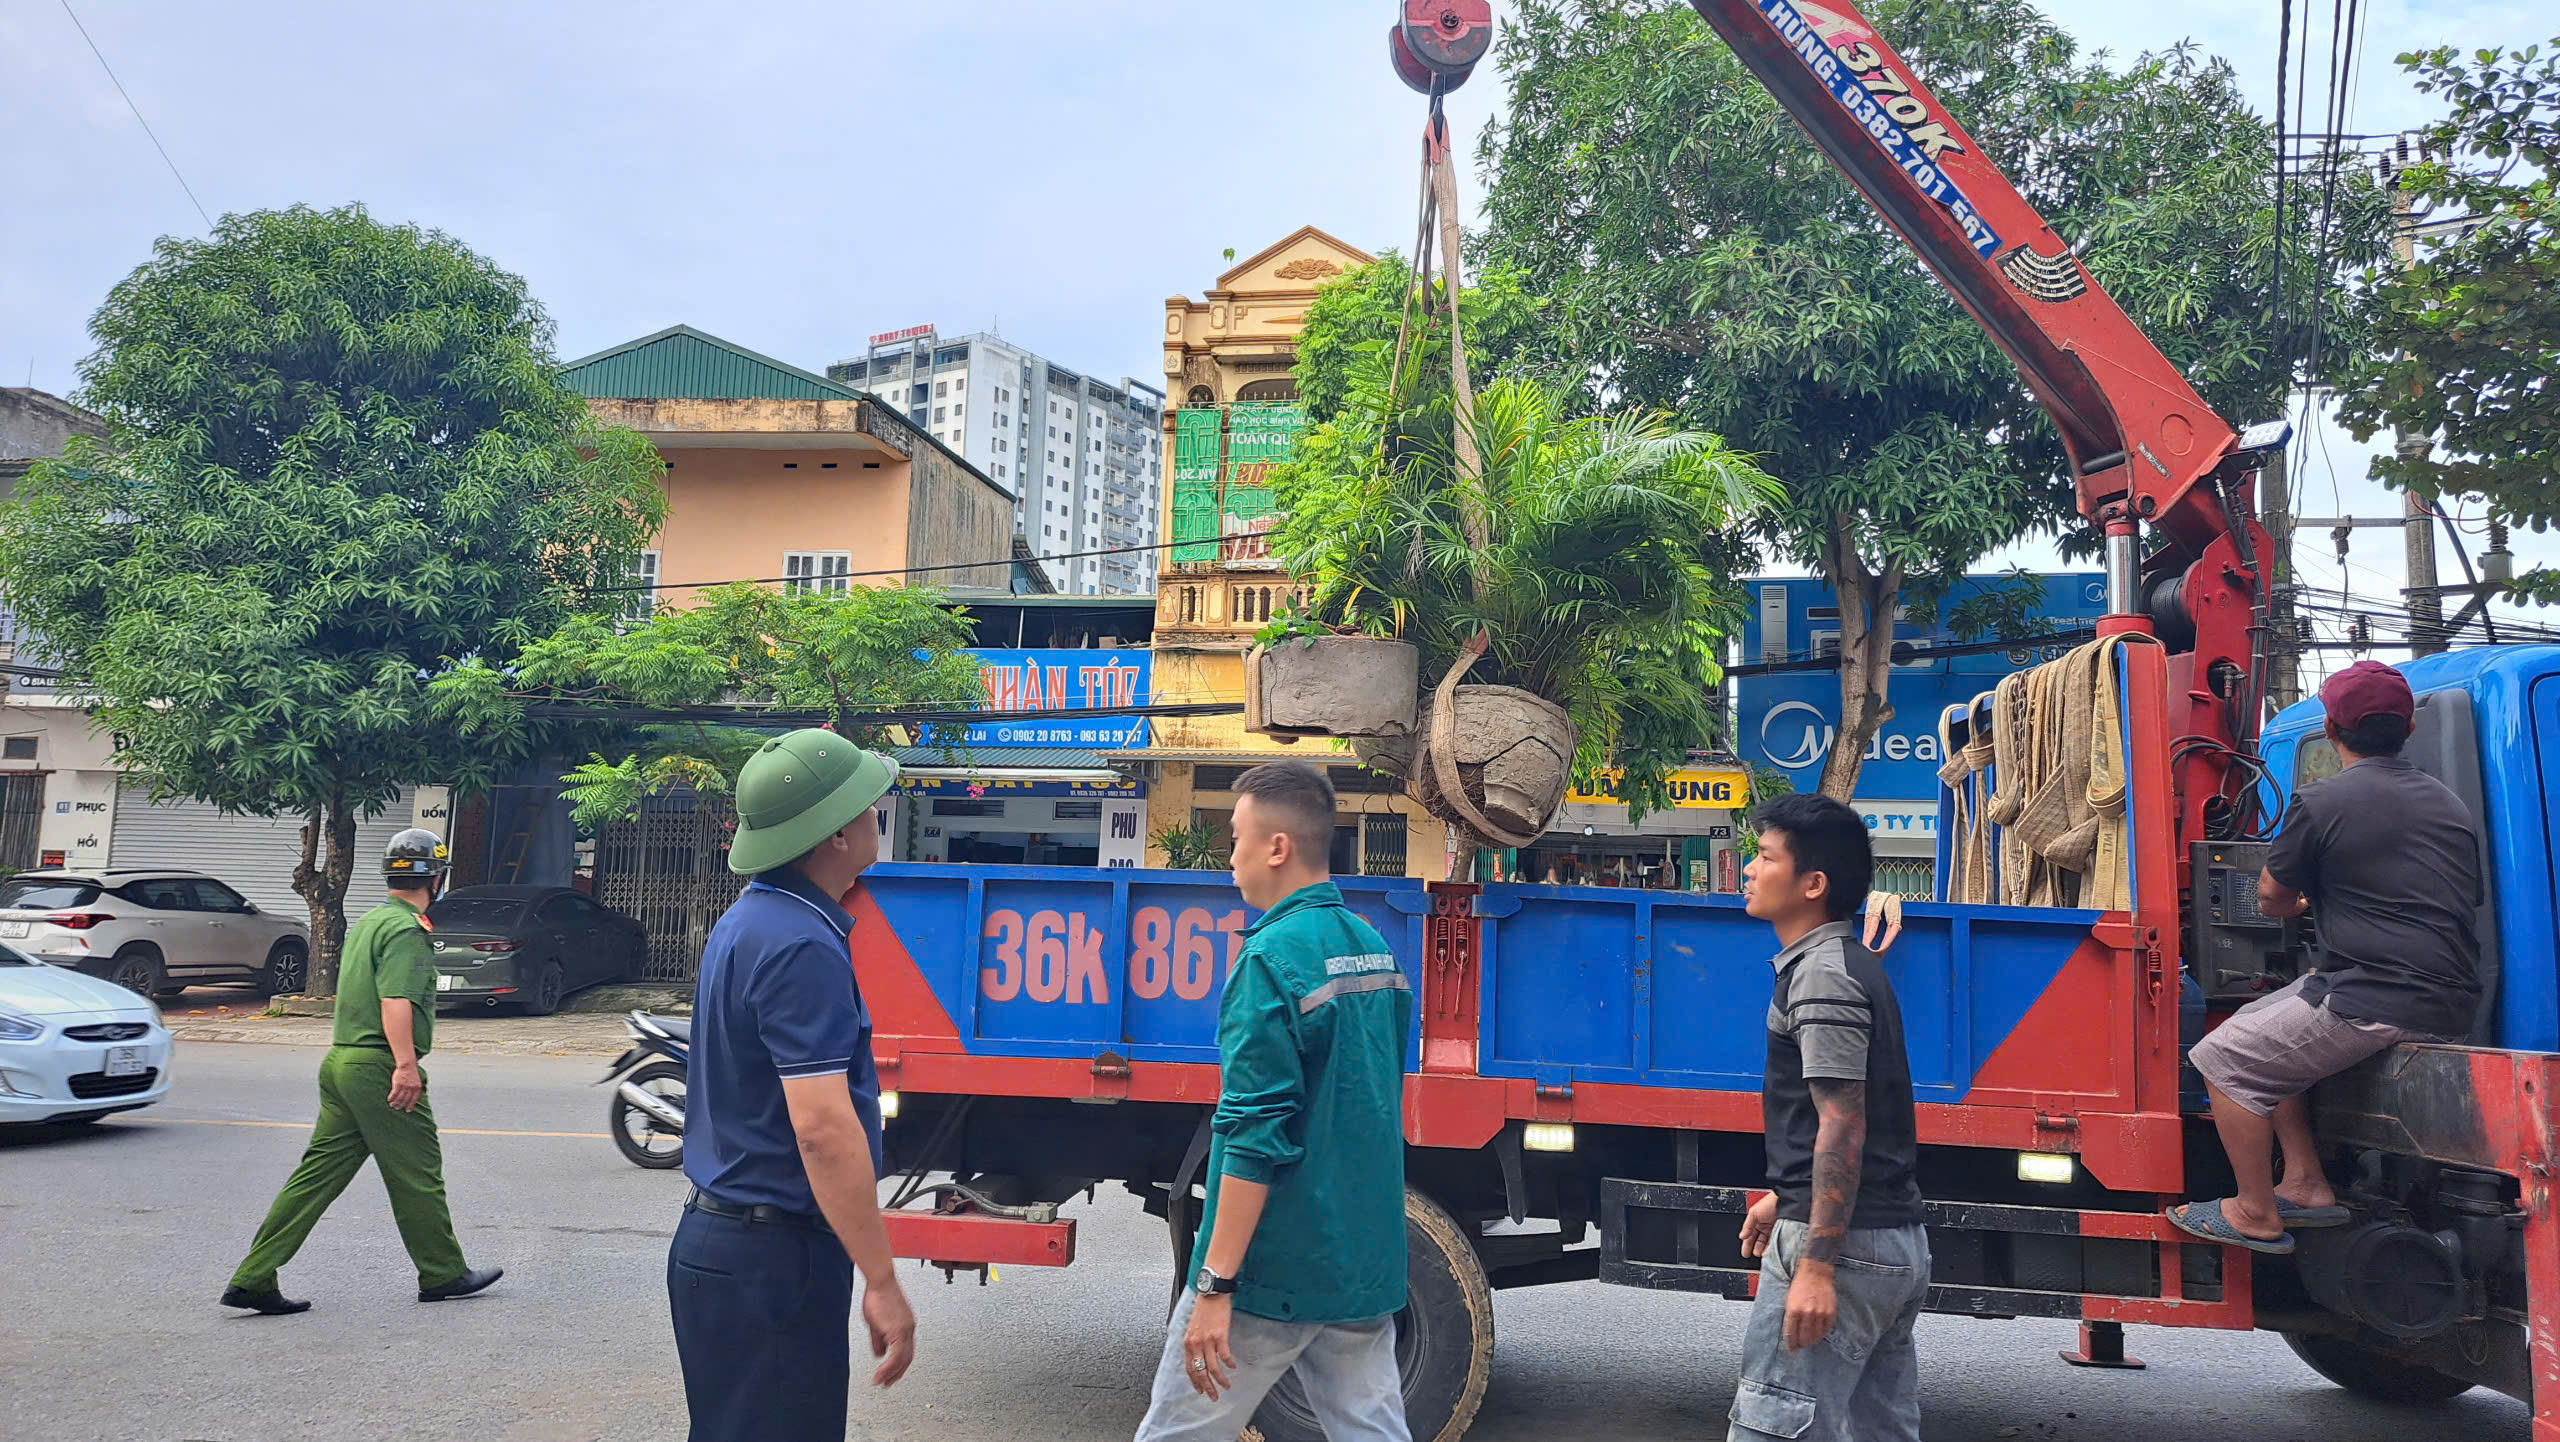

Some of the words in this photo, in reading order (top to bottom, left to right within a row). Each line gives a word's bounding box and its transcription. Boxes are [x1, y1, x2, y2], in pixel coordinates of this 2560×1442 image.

[972, 731, 986, 742] LAI
[1013, 730, 1034, 742] 0902
[1037, 730, 1048, 742] 20
[1050, 730, 1072, 742] 8763
[1080, 730, 1098, 742] 093
[1099, 730, 1111, 742] 63
[1112, 730, 1124, 742] 20
[1125, 730, 1142, 742] 77
[1767, 704, 1937, 766] Mdea
[1667, 780, 1731, 805] ỤNG
[75, 802, 107, 815] PHỤC
[1111, 807, 1138, 839] PHỦ
[1884, 815, 1913, 830] TY
[1712, 827, 1728, 836] 73
